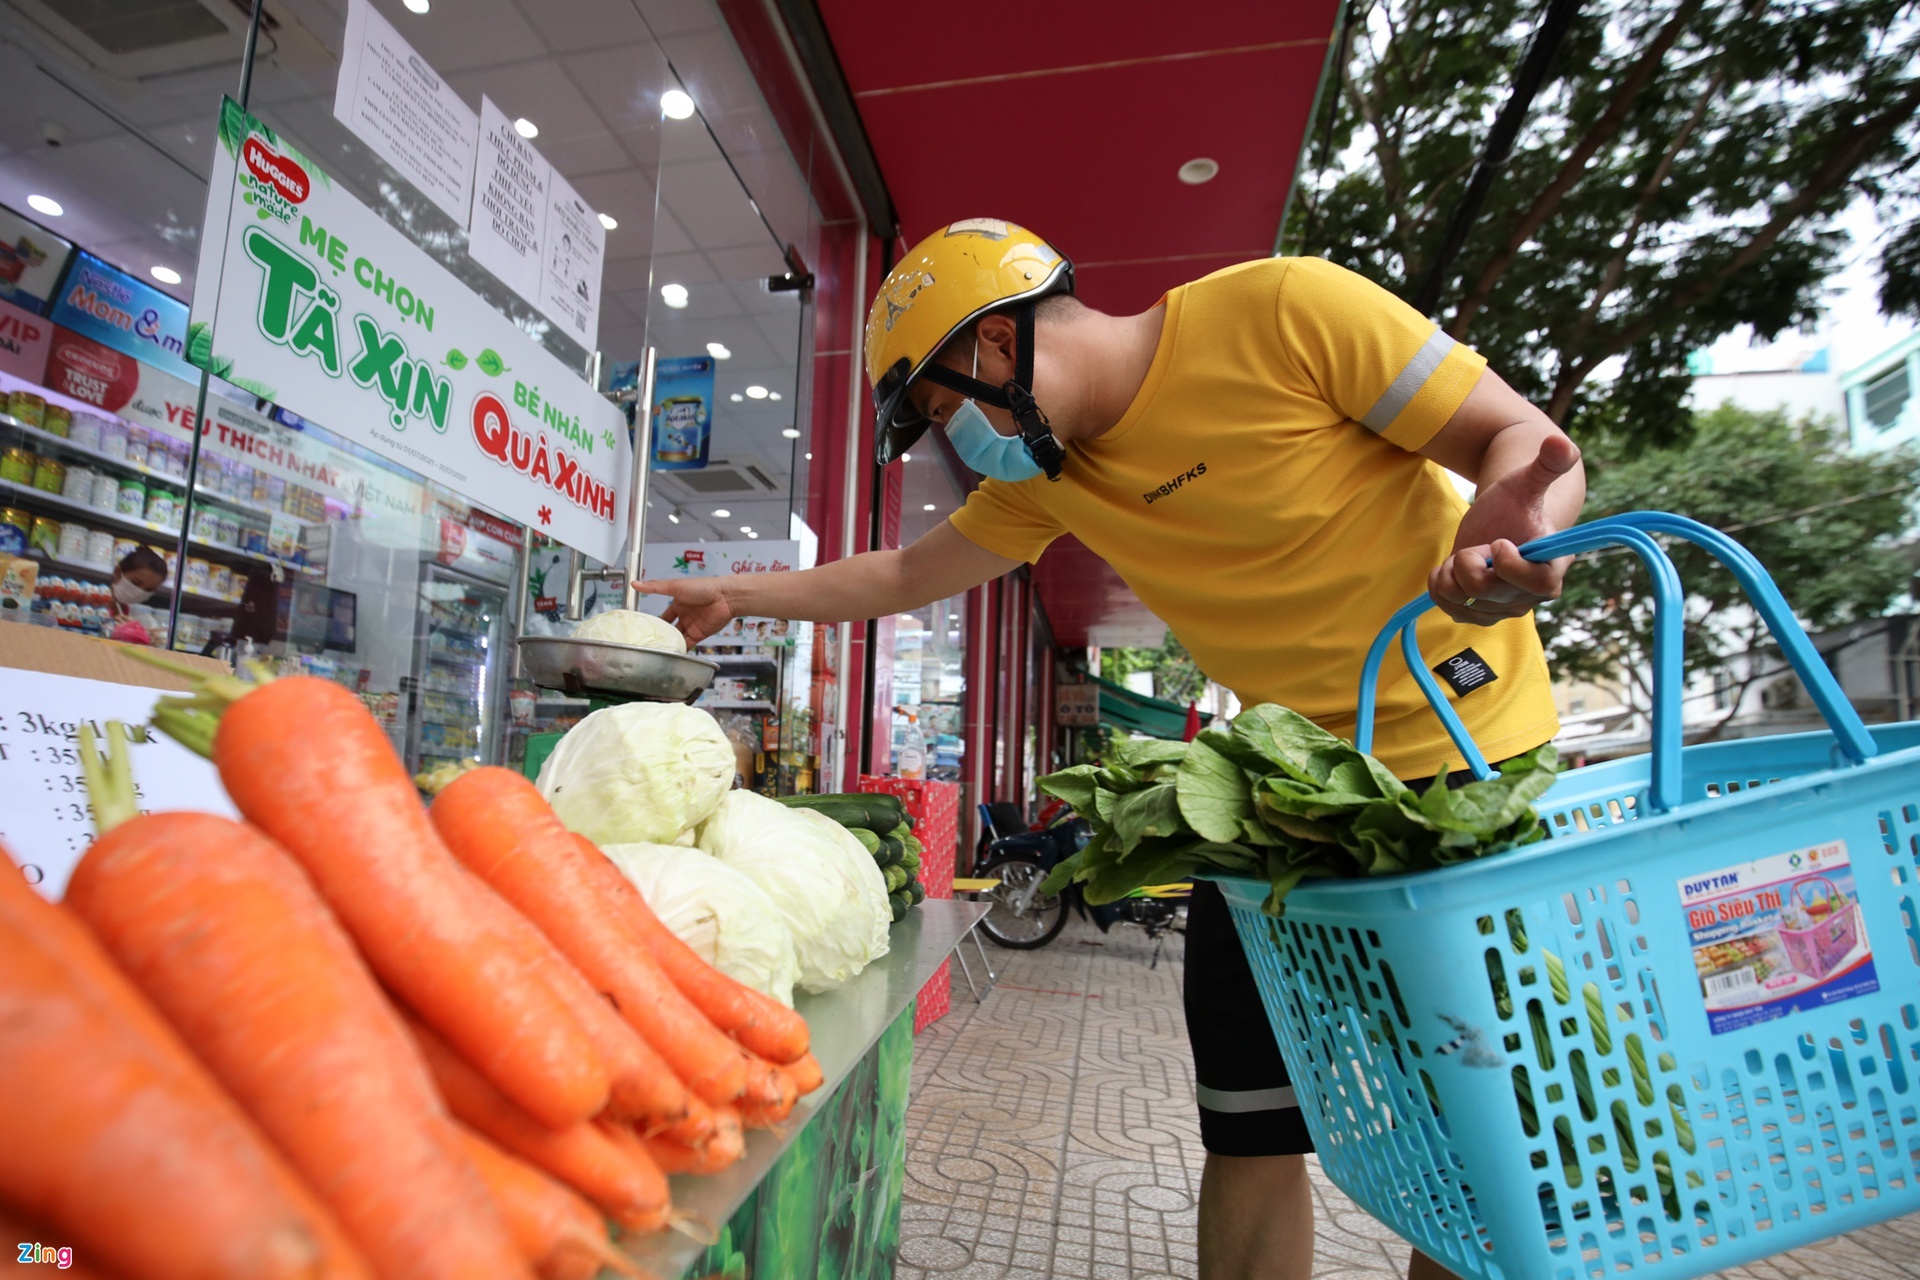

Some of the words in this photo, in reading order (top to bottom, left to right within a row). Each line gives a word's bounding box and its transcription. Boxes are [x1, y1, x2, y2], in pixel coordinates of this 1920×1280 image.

[249, 146, 304, 199] HUGGIES
[249, 174, 298, 218] nature
[299, 217, 348, 276] MẸ
[354, 256, 434, 332] CHỌN
[68, 285, 132, 330] Mom
[134, 309, 160, 345] &
[246, 230, 339, 373] TÃ
[350, 318, 450, 431] XỊN
[66, 369, 109, 393] TRUST
[69, 382, 104, 405] LOVE
[514, 380, 539, 417] BÉ
[543, 403, 594, 454] NHẬN
[217, 422, 285, 466] THÍCH
[287, 455, 340, 487] NHẤT
[473, 393, 549, 484] QUÀ
[555, 447, 616, 521] XINH
[731, 560, 754, 574] Ghế
[755, 561, 767, 573] ăn
[1684, 872, 1738, 895] DUYTAN
[1718, 898, 1755, 923] Siêu
[1755, 888, 1782, 912] Thị
[1693, 925, 1738, 942] Shopping
